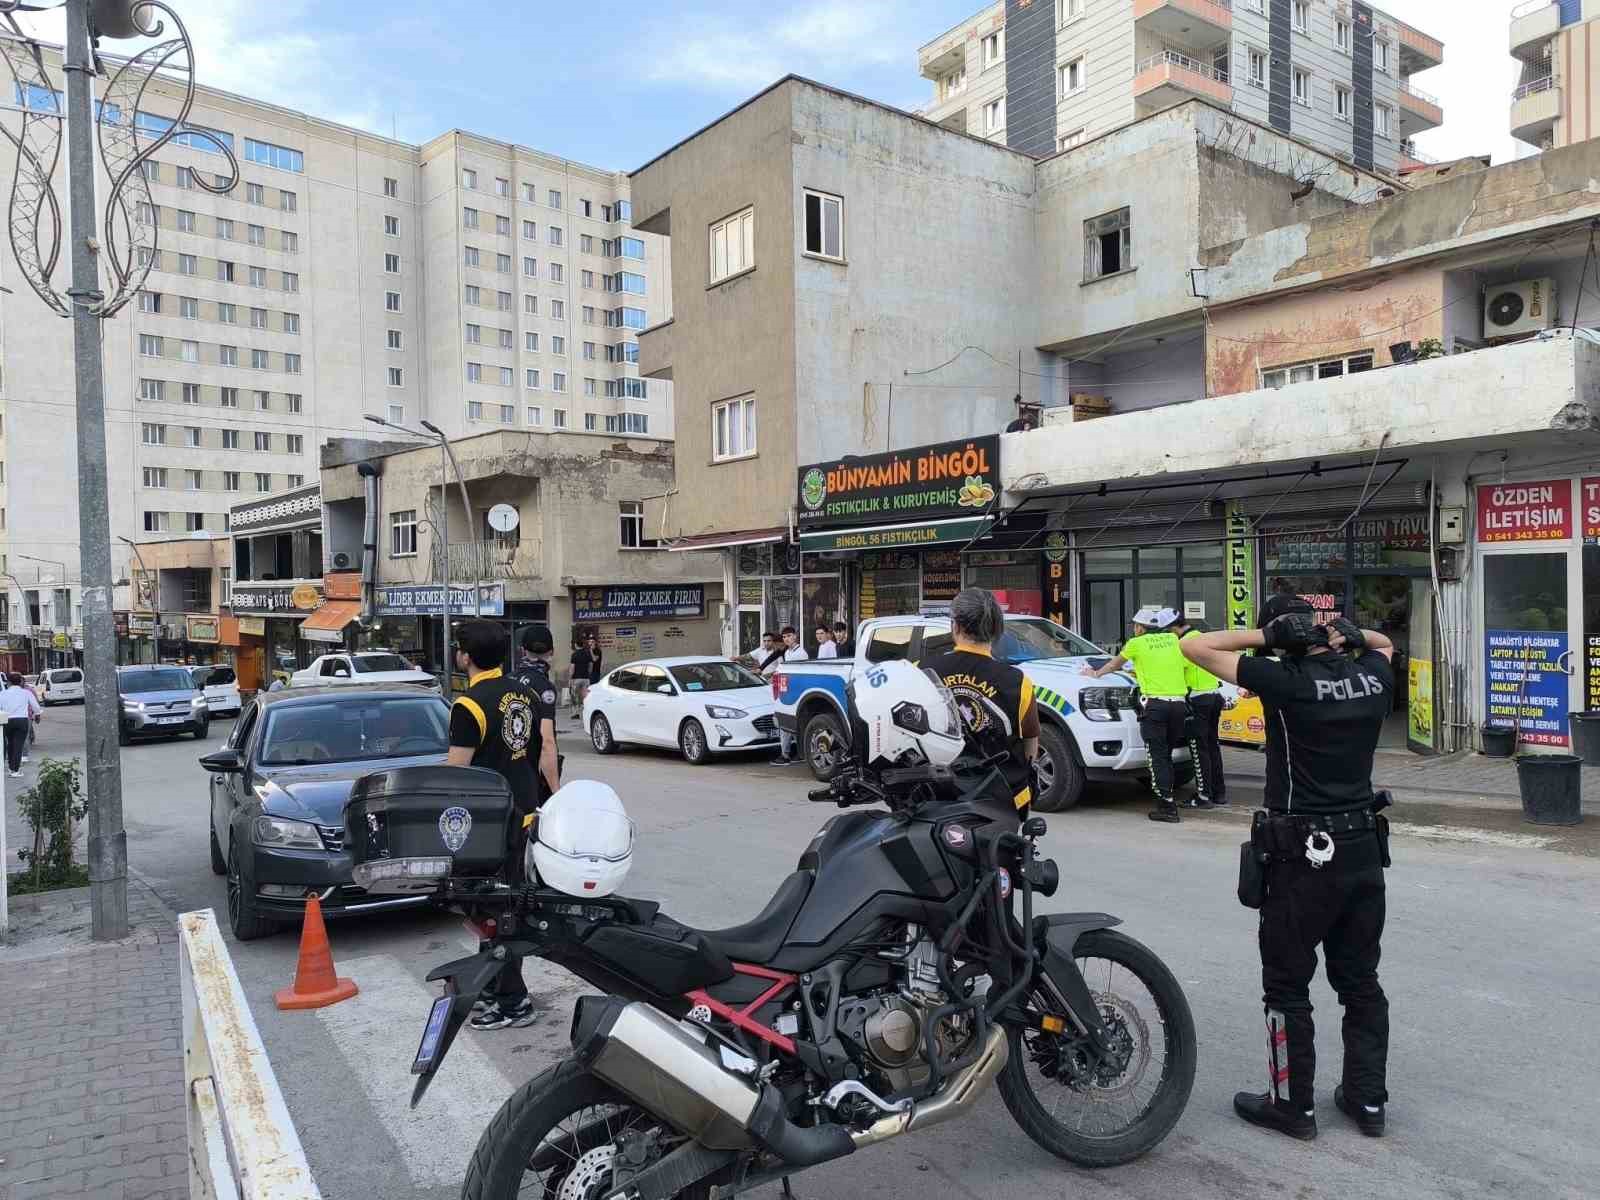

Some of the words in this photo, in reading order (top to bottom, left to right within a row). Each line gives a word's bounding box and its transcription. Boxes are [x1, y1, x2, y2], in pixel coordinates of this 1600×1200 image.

[827, 456, 911, 493] BÜNYAMİN
[918, 443, 989, 480] BİNGÖL
[827, 499, 880, 515] FISTIKÇILIK
[884, 496, 890, 509] &
[893, 487, 957, 509] KURUYEMİŞ
[1492, 487, 1553, 506] ÖZDEN
[1486, 505, 1564, 530] İLETİŞİM
[881, 527, 938, 545] FISTIKÇILIK
[1550, 529, 1563, 538] 00
[1490, 649, 1513, 657] LAPTOP
[1490, 661, 1512, 669] TABLET
[1315, 672, 1384, 701] POLİS
[1491, 683, 1518, 692] ANAKART
[1490, 694, 1511, 703] EKRAN
